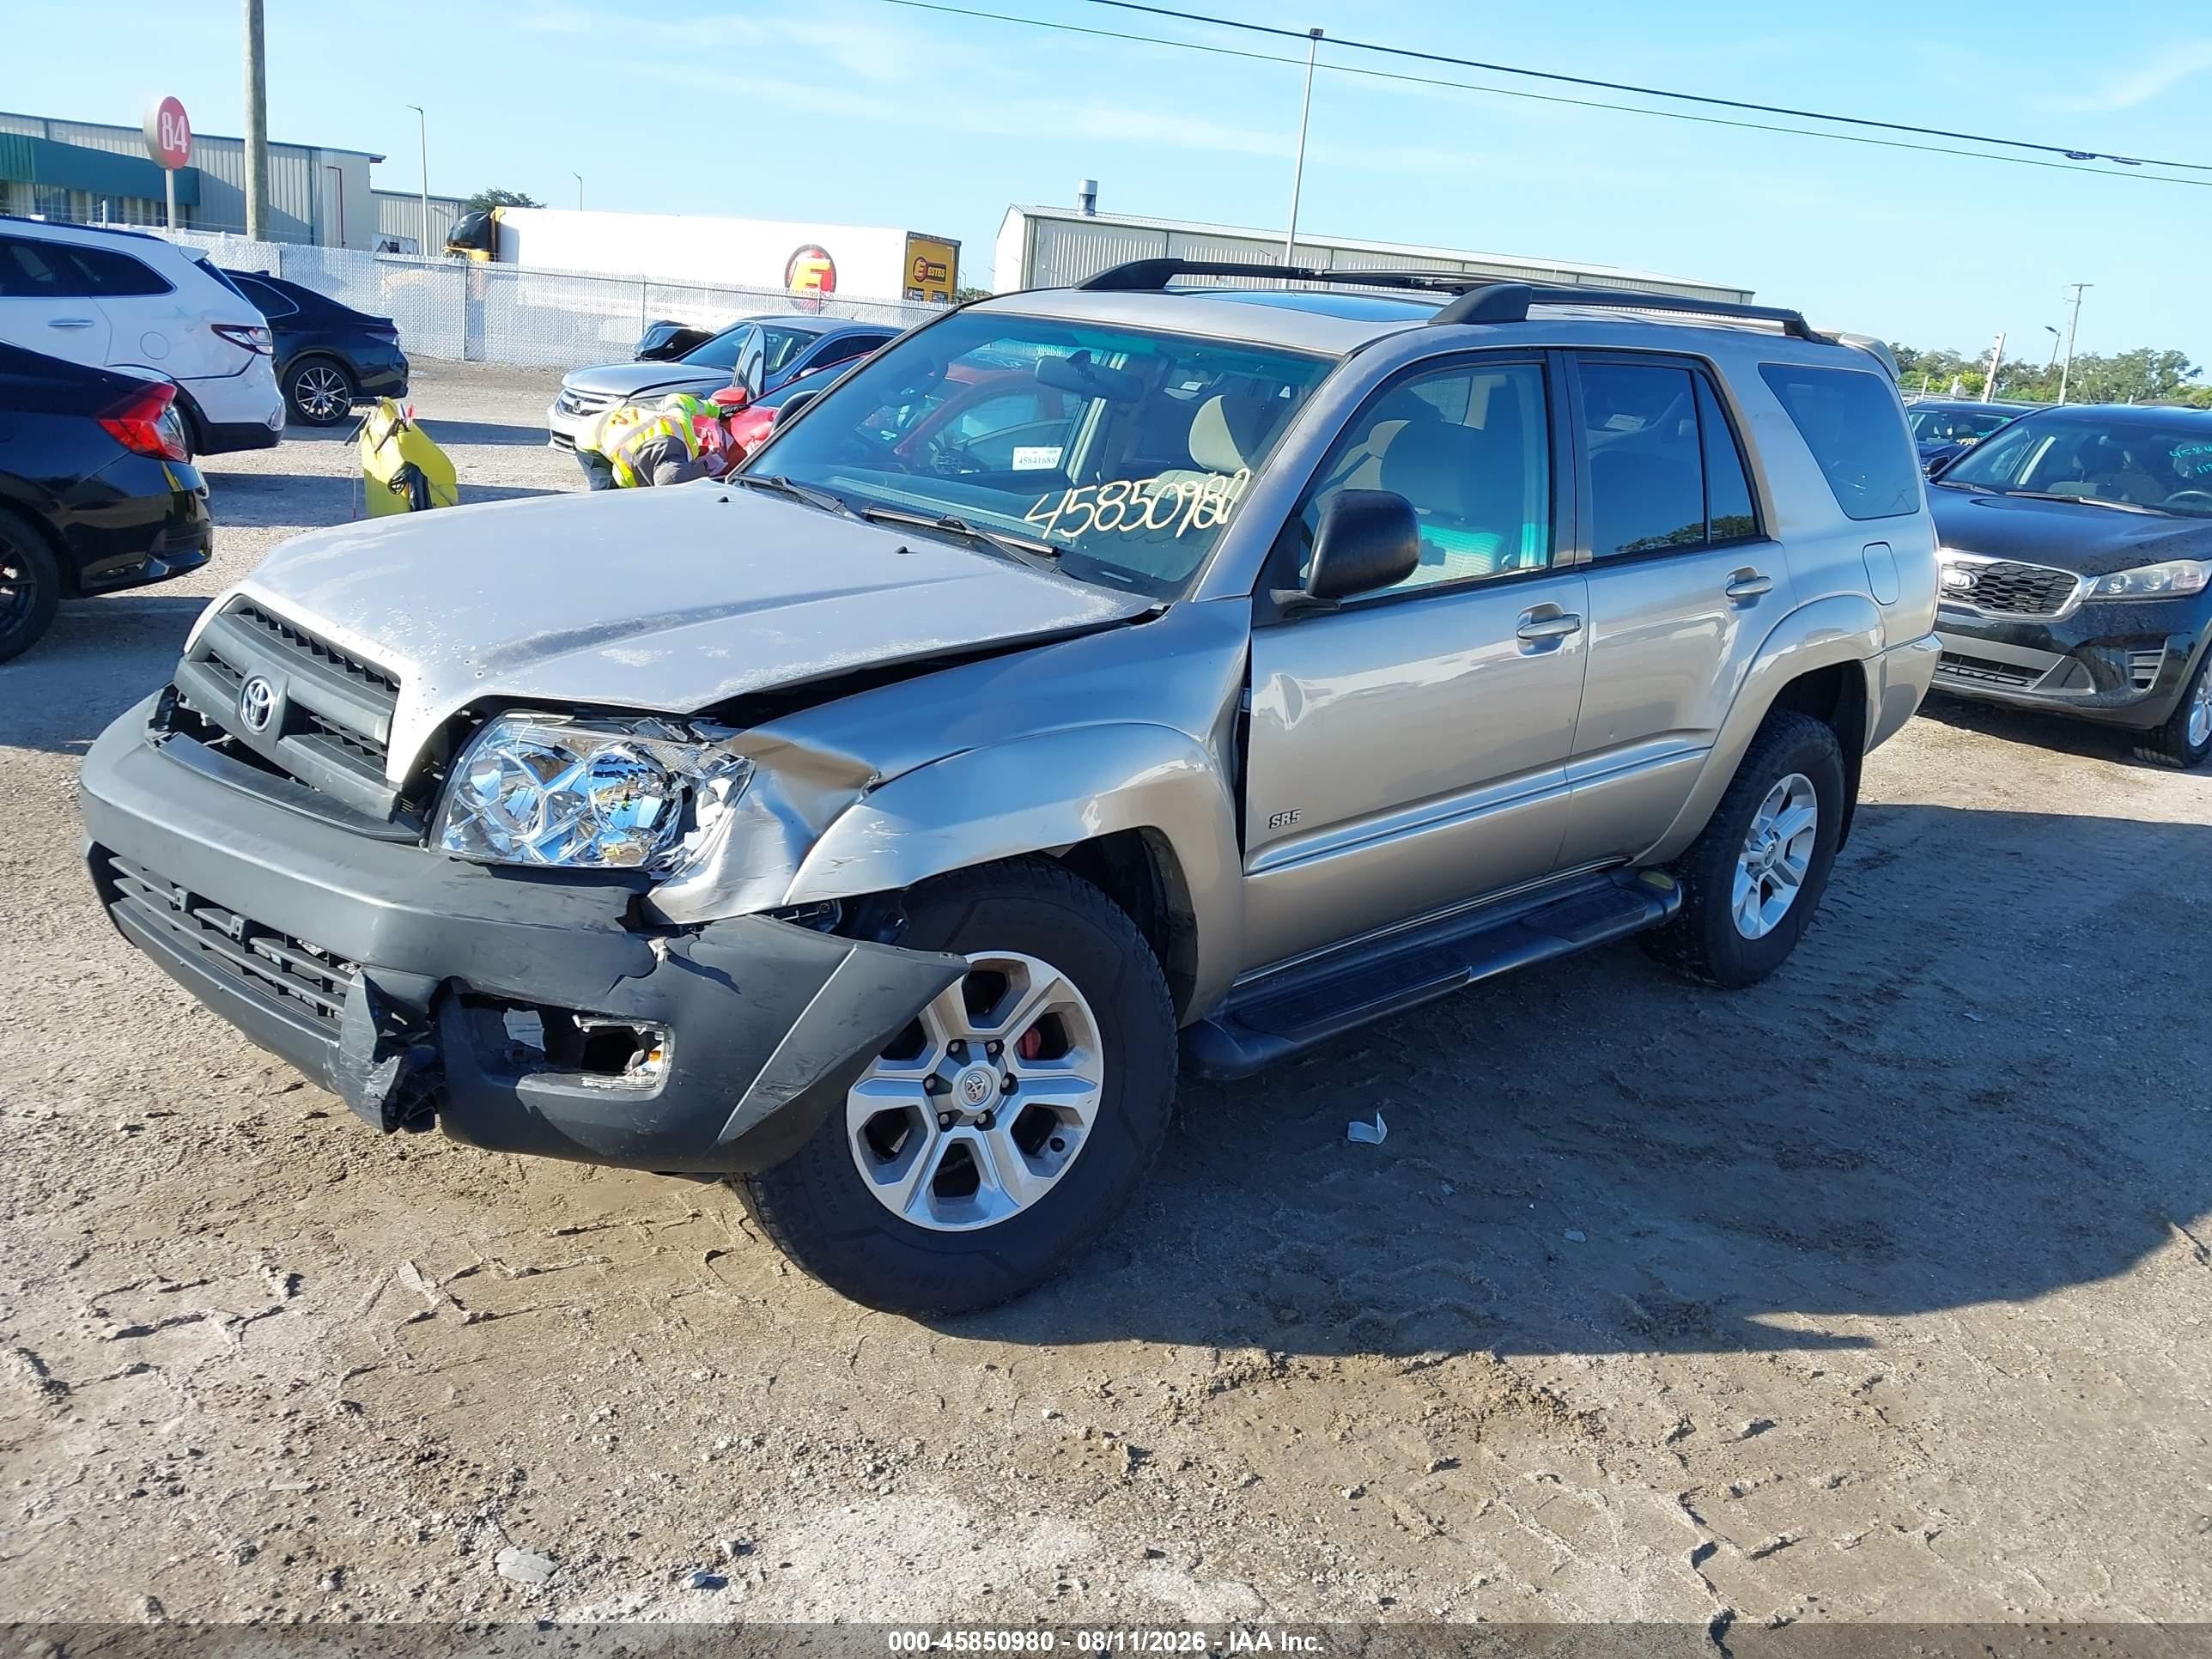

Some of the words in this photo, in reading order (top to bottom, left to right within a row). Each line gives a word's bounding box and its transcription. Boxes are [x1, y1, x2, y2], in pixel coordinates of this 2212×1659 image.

[161, 112, 187, 153] 84
[927, 266, 945, 277] ESTES
[1024, 467, 1251, 539] 45850980
[1268, 808, 1302, 830] SR5
